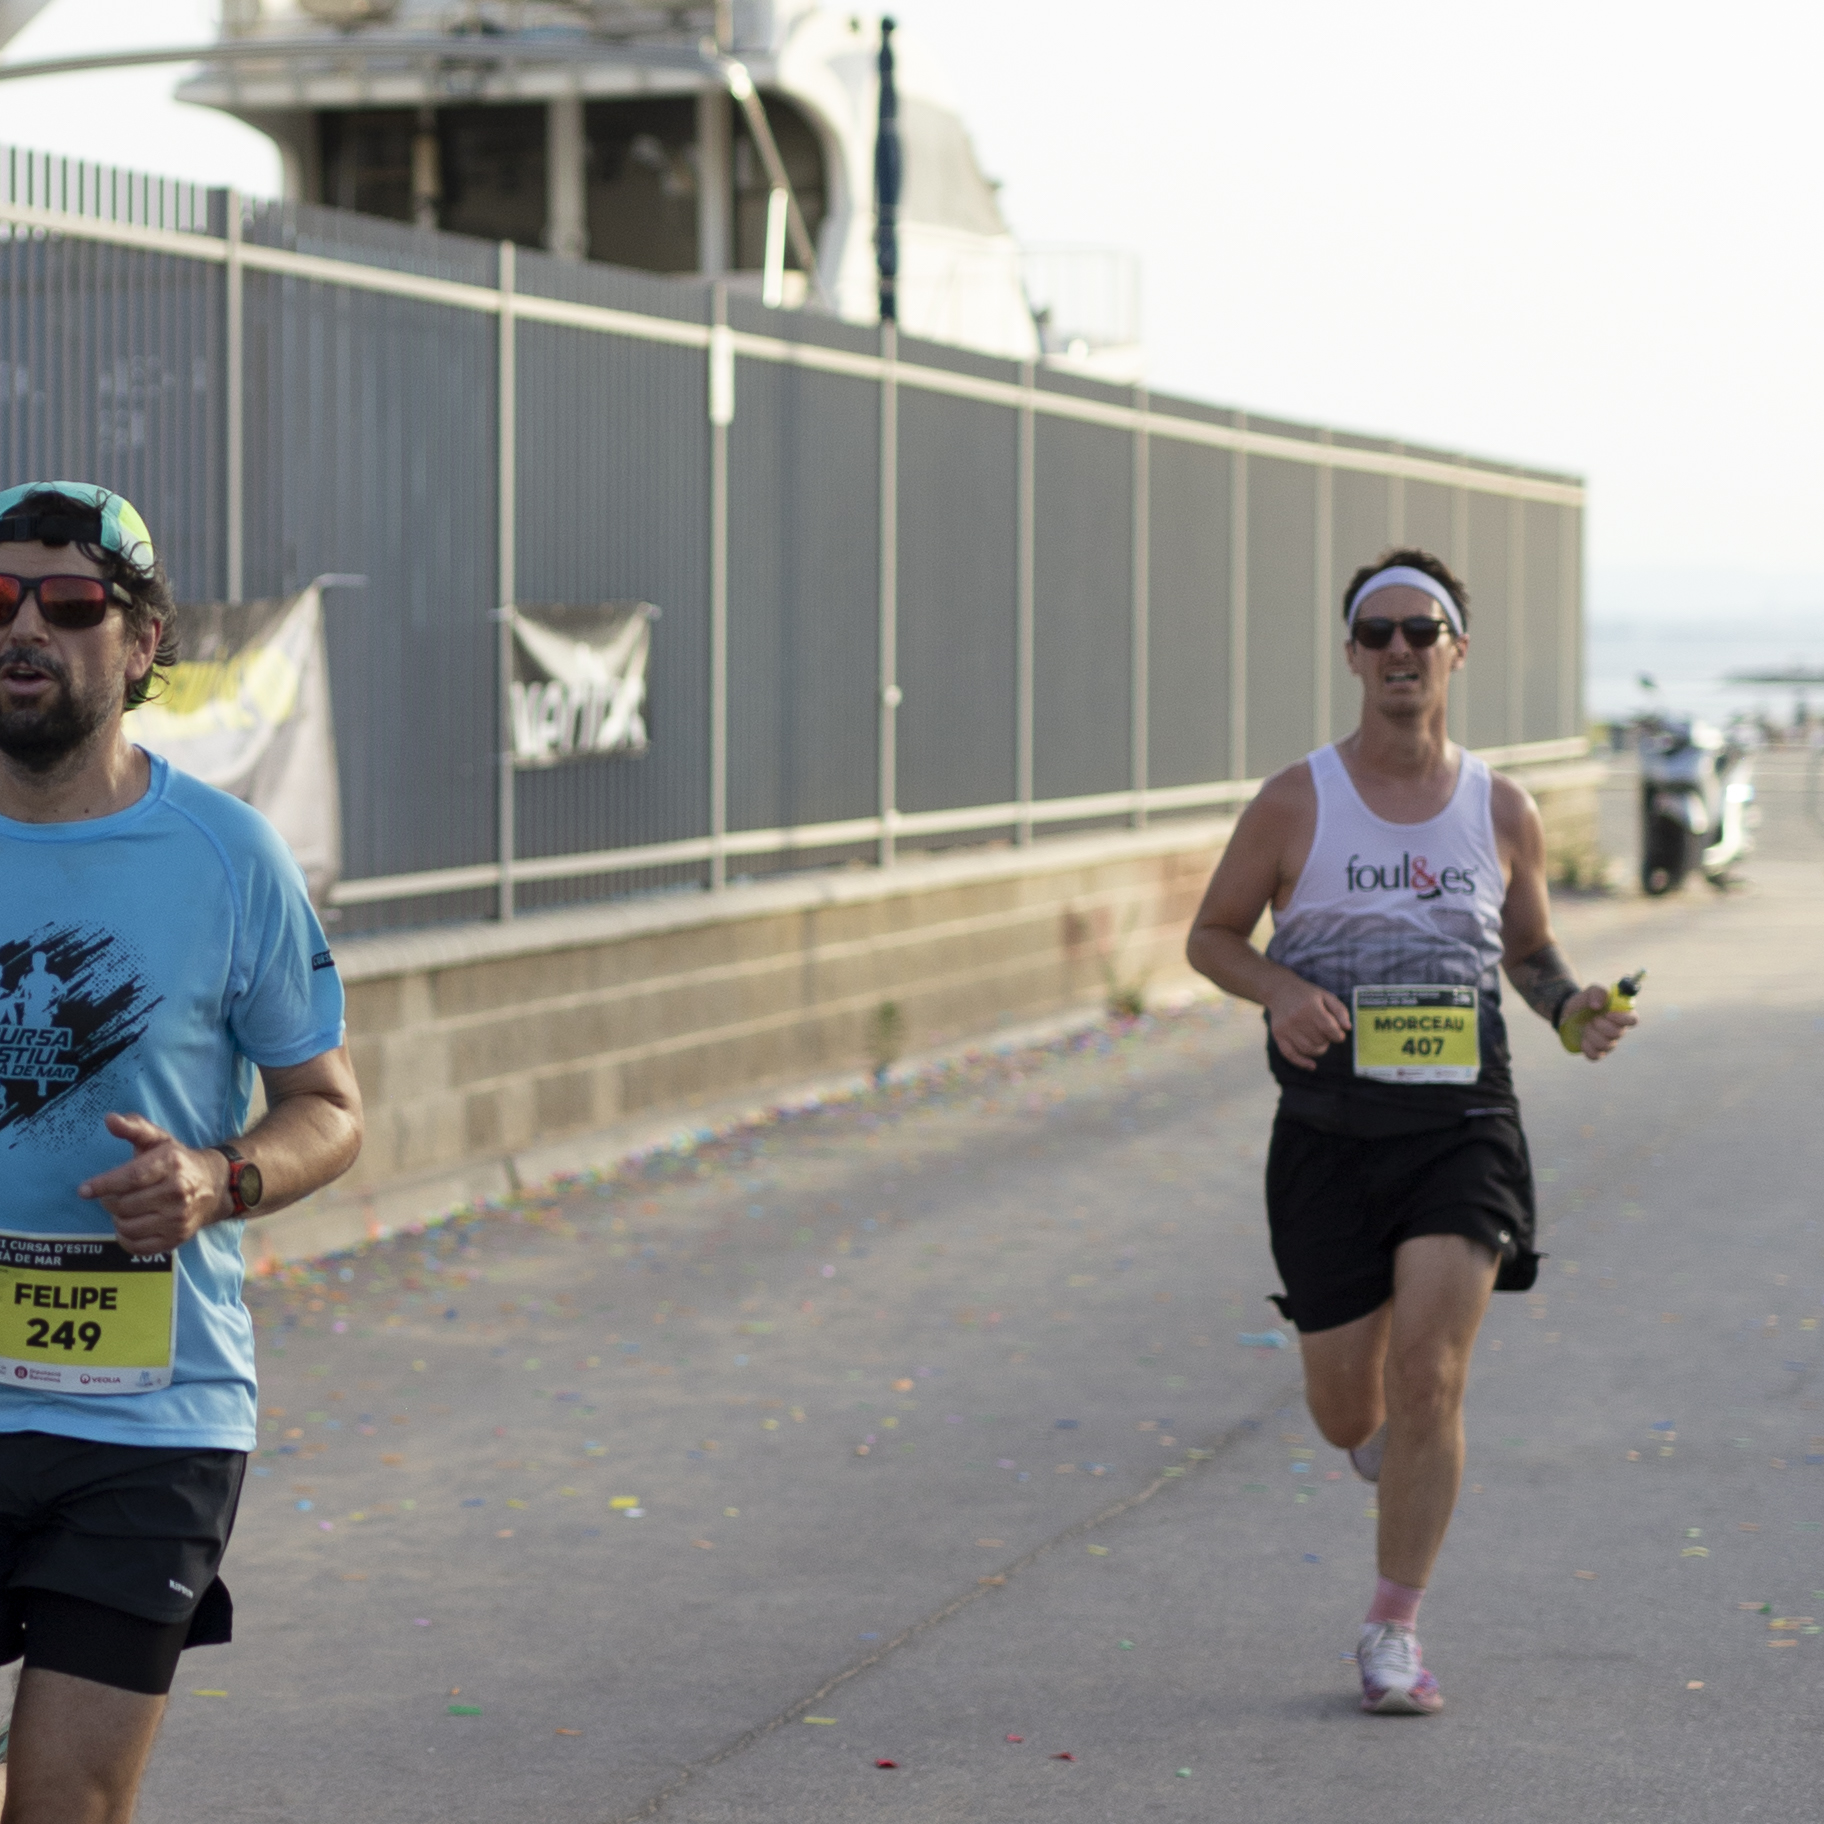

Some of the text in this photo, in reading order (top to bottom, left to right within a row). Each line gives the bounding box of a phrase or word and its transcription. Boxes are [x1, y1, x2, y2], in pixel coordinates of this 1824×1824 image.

[1401, 1037, 1445, 1056] 407
[11, 1064, 35, 1077] DE
[36, 1066, 76, 1079] MAR
[9, 1240, 52, 1254] CURSA
[54, 1243, 104, 1255] D'ESTIU
[14, 1252, 31, 1264] DE
[34, 1255, 62, 1266] MAR
[13, 1282, 119, 1311] FELIPE
[25, 1317, 103, 1352] 249
[91, 1376, 121, 1384] VEOLIA
